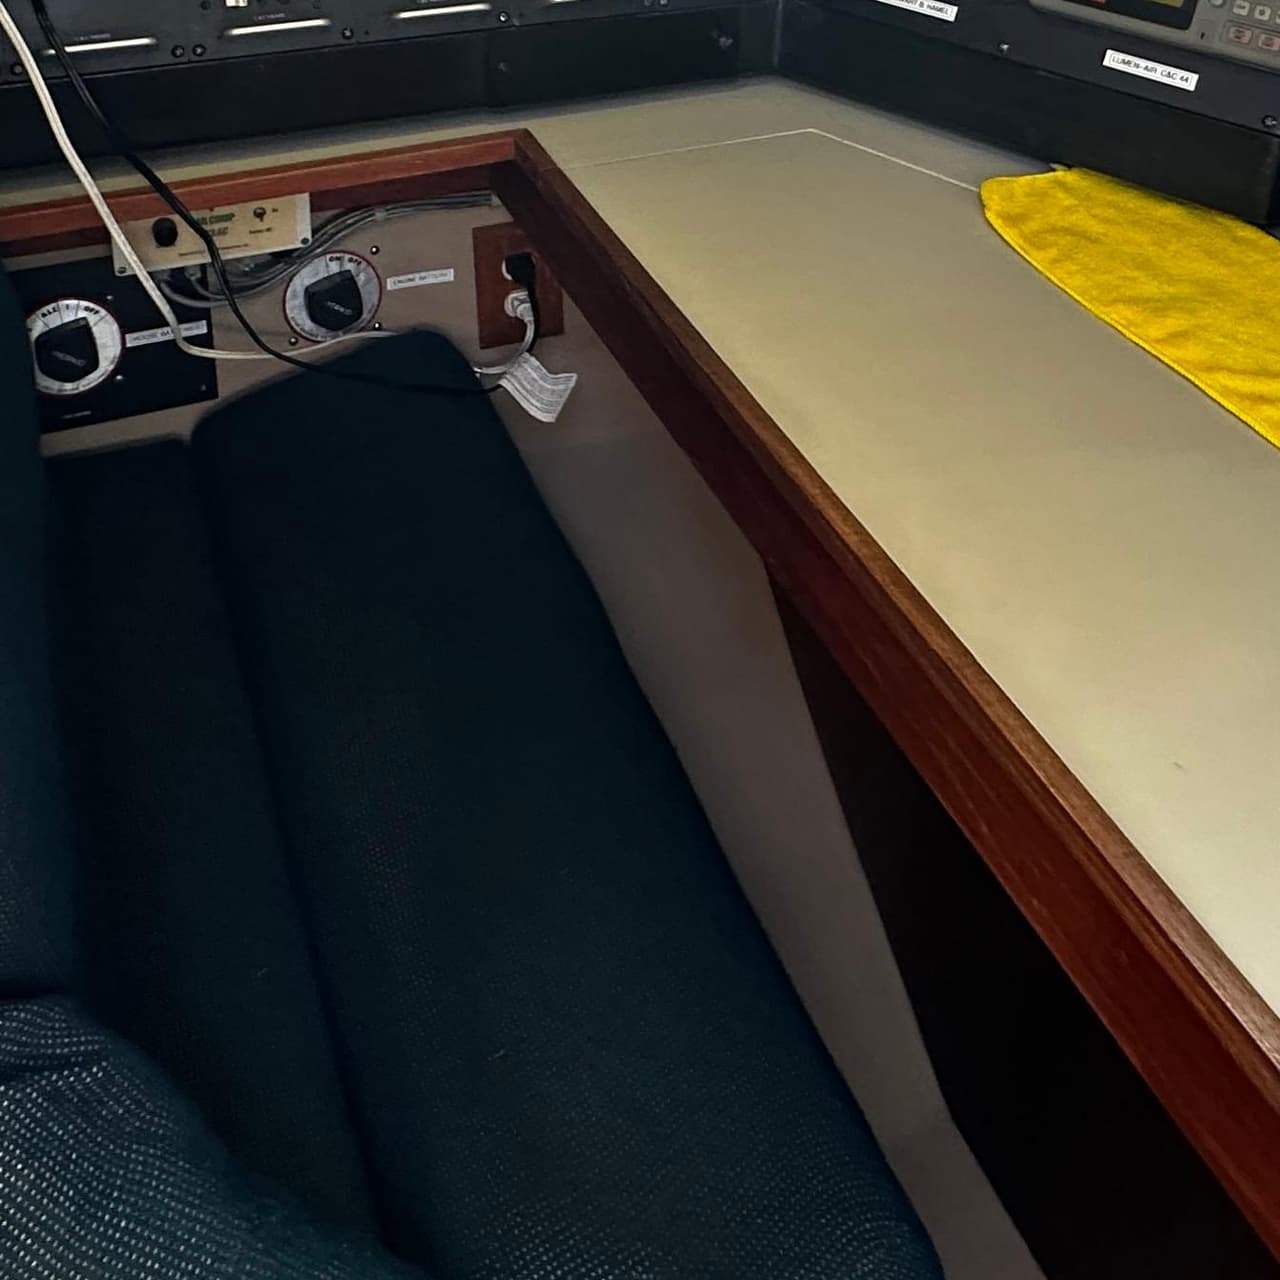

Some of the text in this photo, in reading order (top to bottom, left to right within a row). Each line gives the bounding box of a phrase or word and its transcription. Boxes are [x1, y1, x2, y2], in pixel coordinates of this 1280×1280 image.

[328, 255, 342, 263] ON
[347, 255, 362, 266] OFF
[83, 305, 100, 316] OFF
